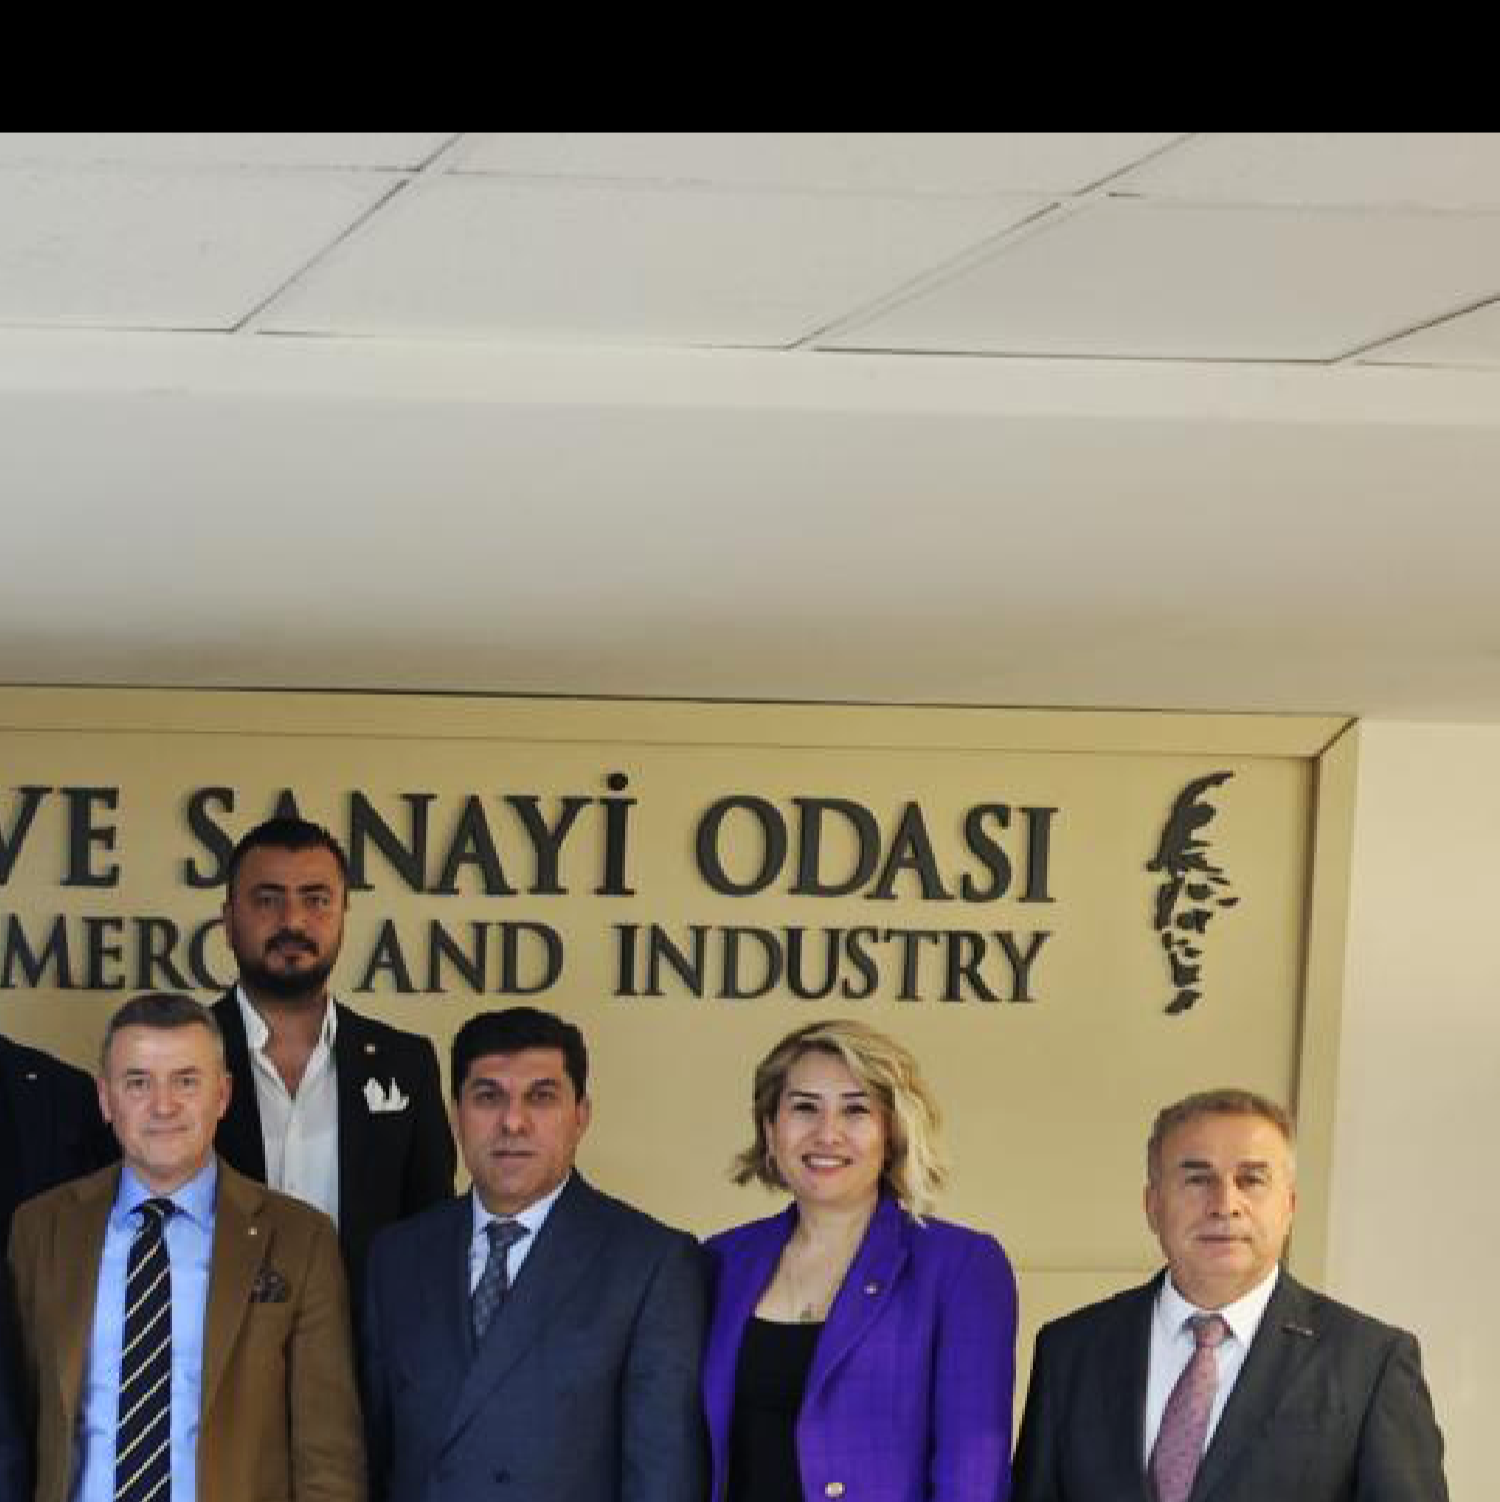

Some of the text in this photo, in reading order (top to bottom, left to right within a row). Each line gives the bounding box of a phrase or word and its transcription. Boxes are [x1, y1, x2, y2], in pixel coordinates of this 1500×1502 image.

[184, 772, 638, 897] SNAYİ
[695, 795, 1059, 904] ODASI
[352, 918, 565, 995] AND
[612, 923, 1052, 1004] INDUSTRY
